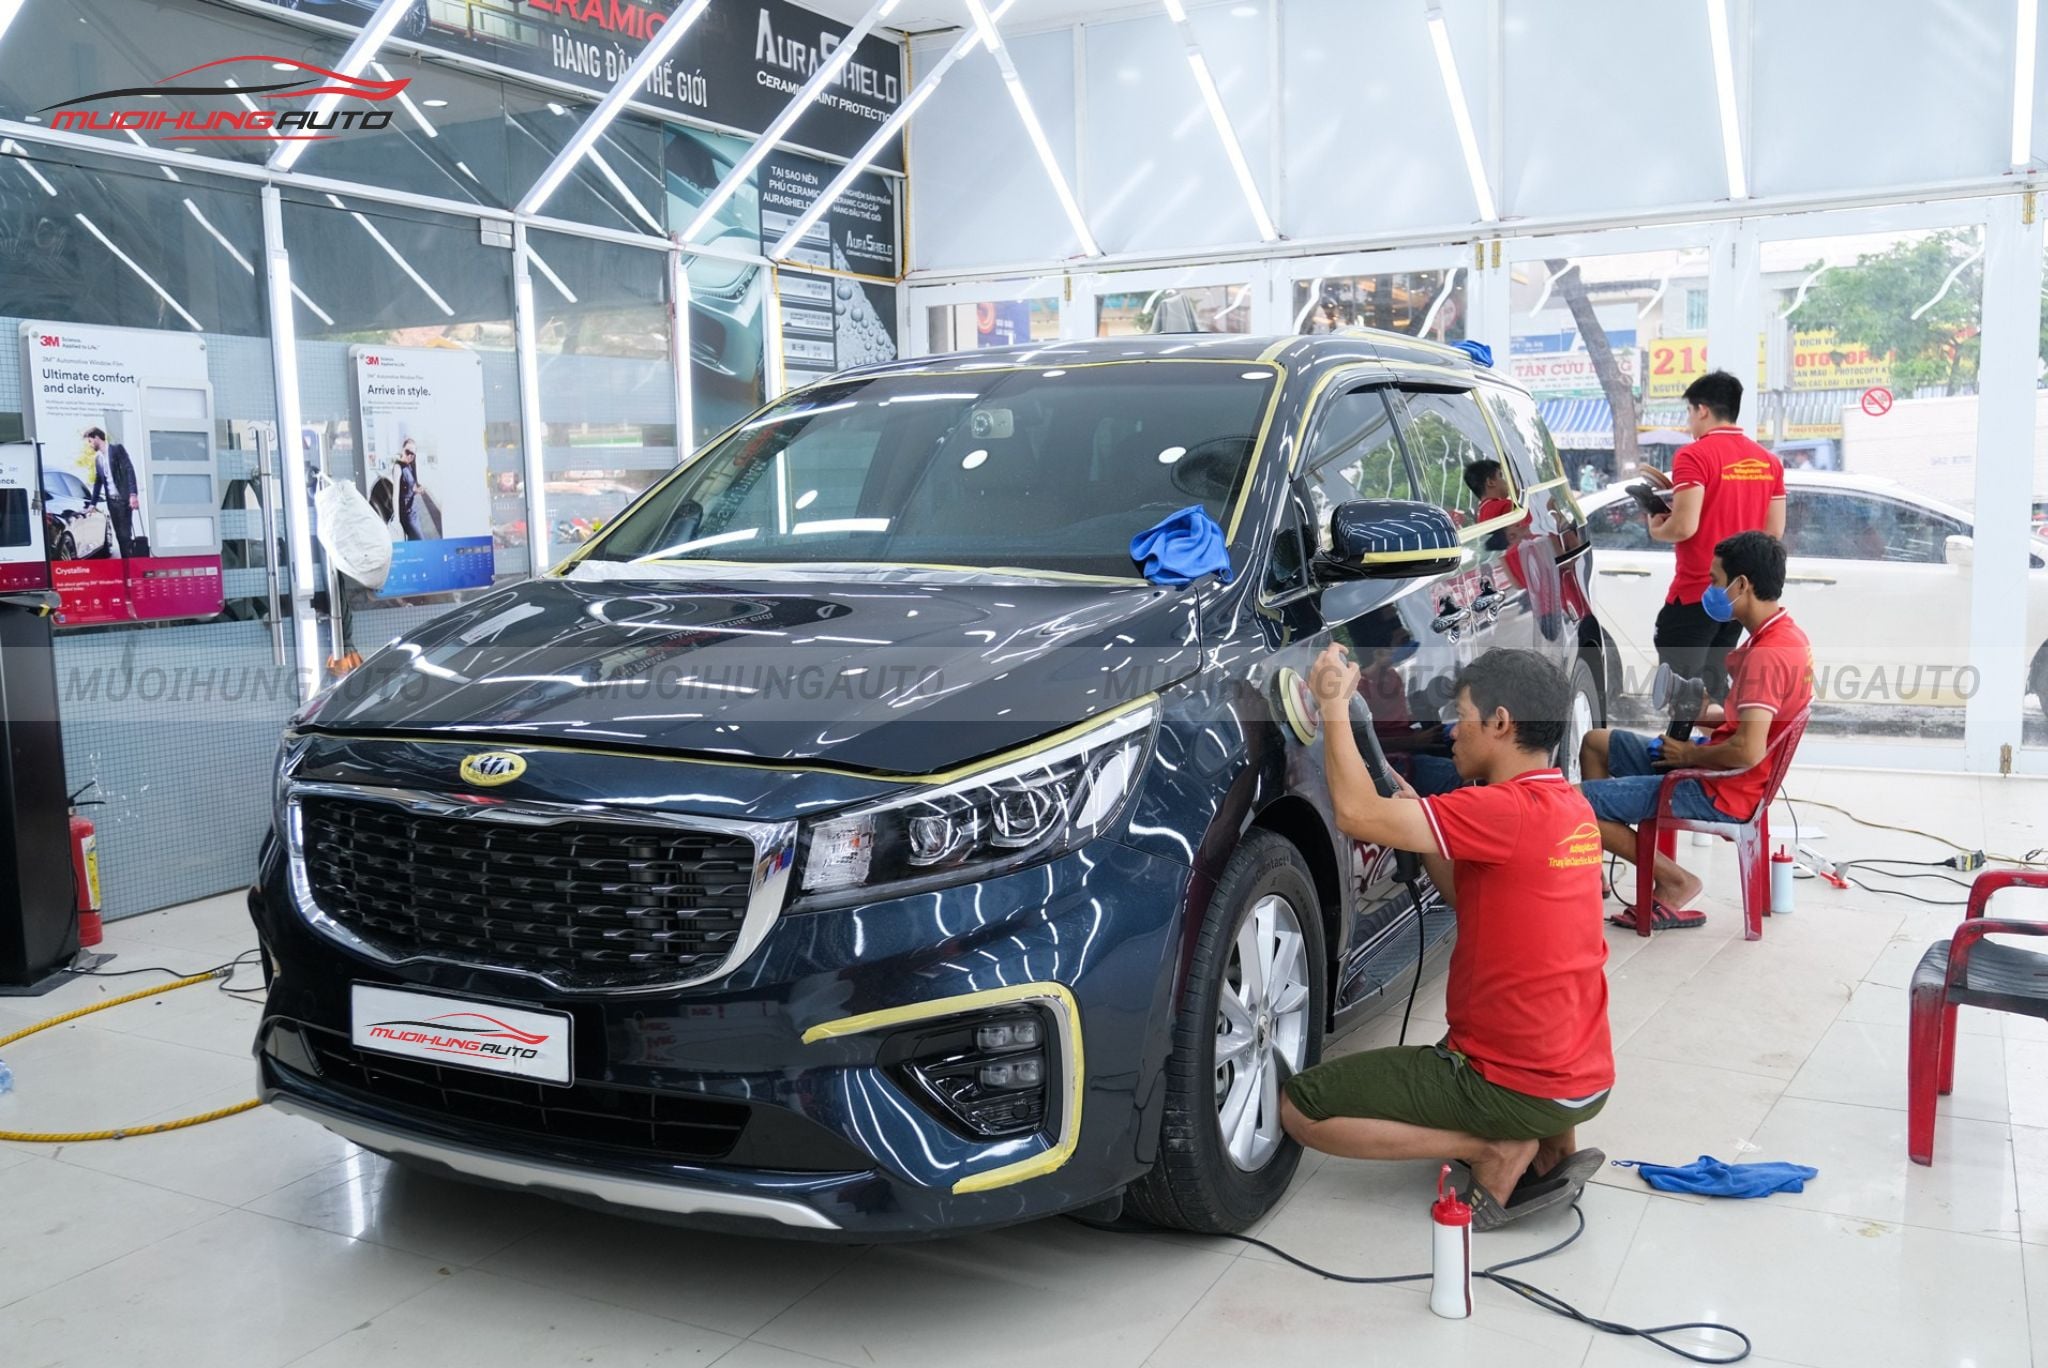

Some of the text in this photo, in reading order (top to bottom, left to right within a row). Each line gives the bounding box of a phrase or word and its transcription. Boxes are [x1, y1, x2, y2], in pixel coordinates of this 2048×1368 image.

[552, 28, 600, 78] HÀNG
[677, 69, 707, 108] GIỚI
[813, 92, 839, 107] AINT
[839, 98, 892, 123] PROTECTIO
[770, 166, 784, 179] TẠI
[785, 169, 801, 181] SAO
[769, 179, 821, 198] PHỦ CERAMIC
[40, 335, 60, 347] 3M
[365, 356, 380, 365] 3M
[42, 368, 135, 384] Ultimate comfort
[44, 384, 105, 397] and clarity.
[367, 384, 431, 398] Arrive in style.
[55, 566, 90, 576] Crystalline
